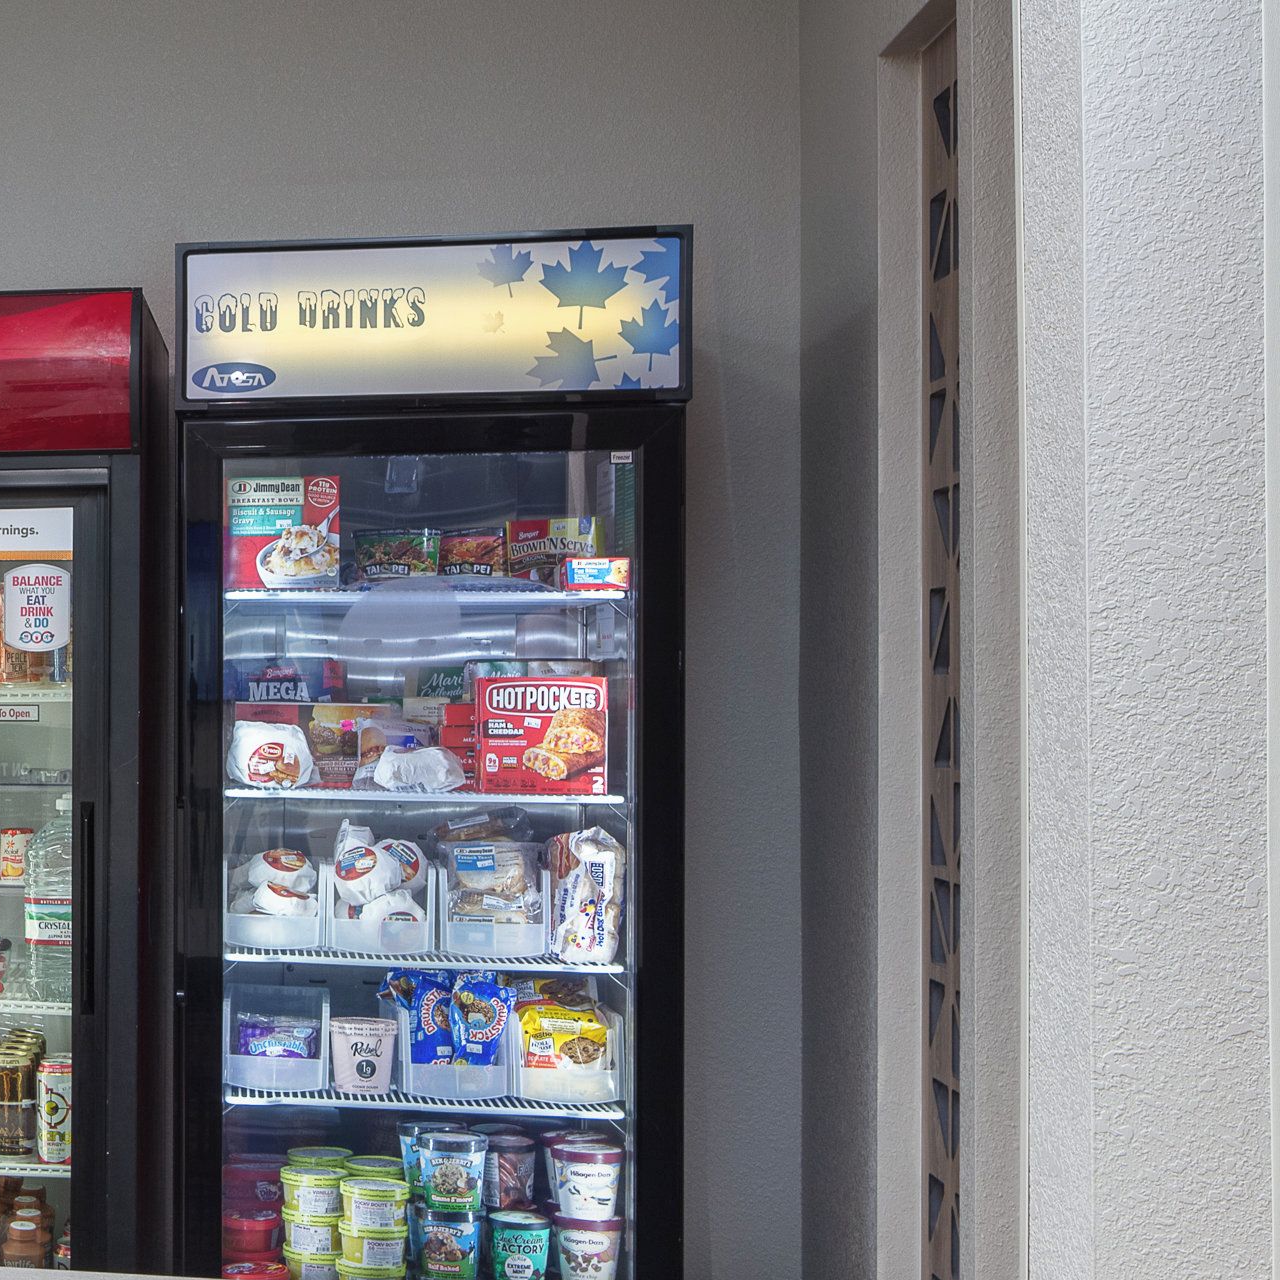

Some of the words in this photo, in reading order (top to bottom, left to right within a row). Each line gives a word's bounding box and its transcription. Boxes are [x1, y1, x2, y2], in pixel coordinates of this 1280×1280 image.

[194, 292, 278, 333] COLD
[298, 287, 426, 329] DRINKS
[202, 367, 266, 387] ATSA
[253, 483, 280, 493] Jimmy
[281, 483, 300, 492] Dean
[233, 508, 258, 516] Biscuit
[266, 508, 295, 517] Sausage
[444, 565, 459, 575] TAI
[473, 564, 491, 575] PEI
[12, 576, 63, 586] BALANCE
[20, 606, 54, 617] DRINK
[24, 618, 32, 628] &
[34, 618, 49, 628] DO
[248, 682, 311, 702] MEGA
[492, 686, 525, 710] HOT
[525, 686, 597, 711] POCKETS
[9, 708, 31, 720] Open
[495, 1242, 545, 1255] FACTORY
